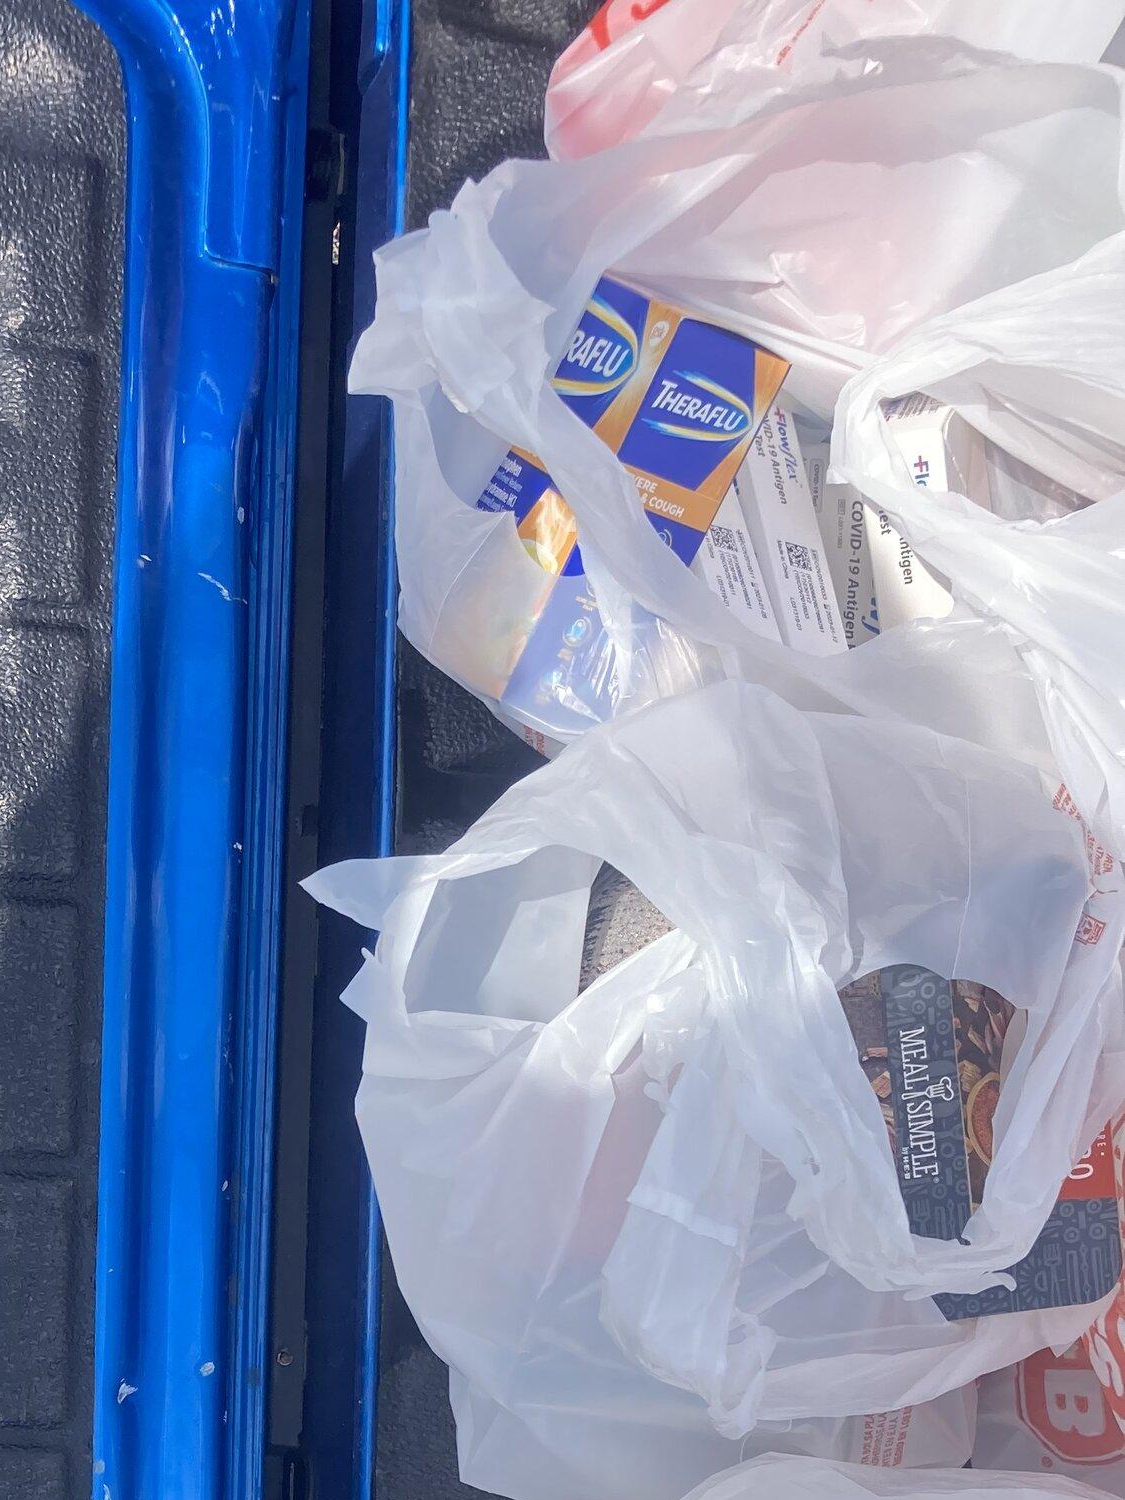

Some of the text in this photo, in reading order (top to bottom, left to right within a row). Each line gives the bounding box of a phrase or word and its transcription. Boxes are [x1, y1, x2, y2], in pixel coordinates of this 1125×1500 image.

[567, 329, 631, 378] RAFLU
[651, 379, 744, 431] THERAFLU
[755, 435, 766, 457] Test
[762, 415, 787, 504] VID-19 Antigen
[649, 496, 685, 518] COUGH
[849, 501, 864, 574] COVID-19
[900, 538, 914, 585] ntigen
[843, 579, 859, 639] Antigen
[899, 1026, 930, 1091] MEAL
